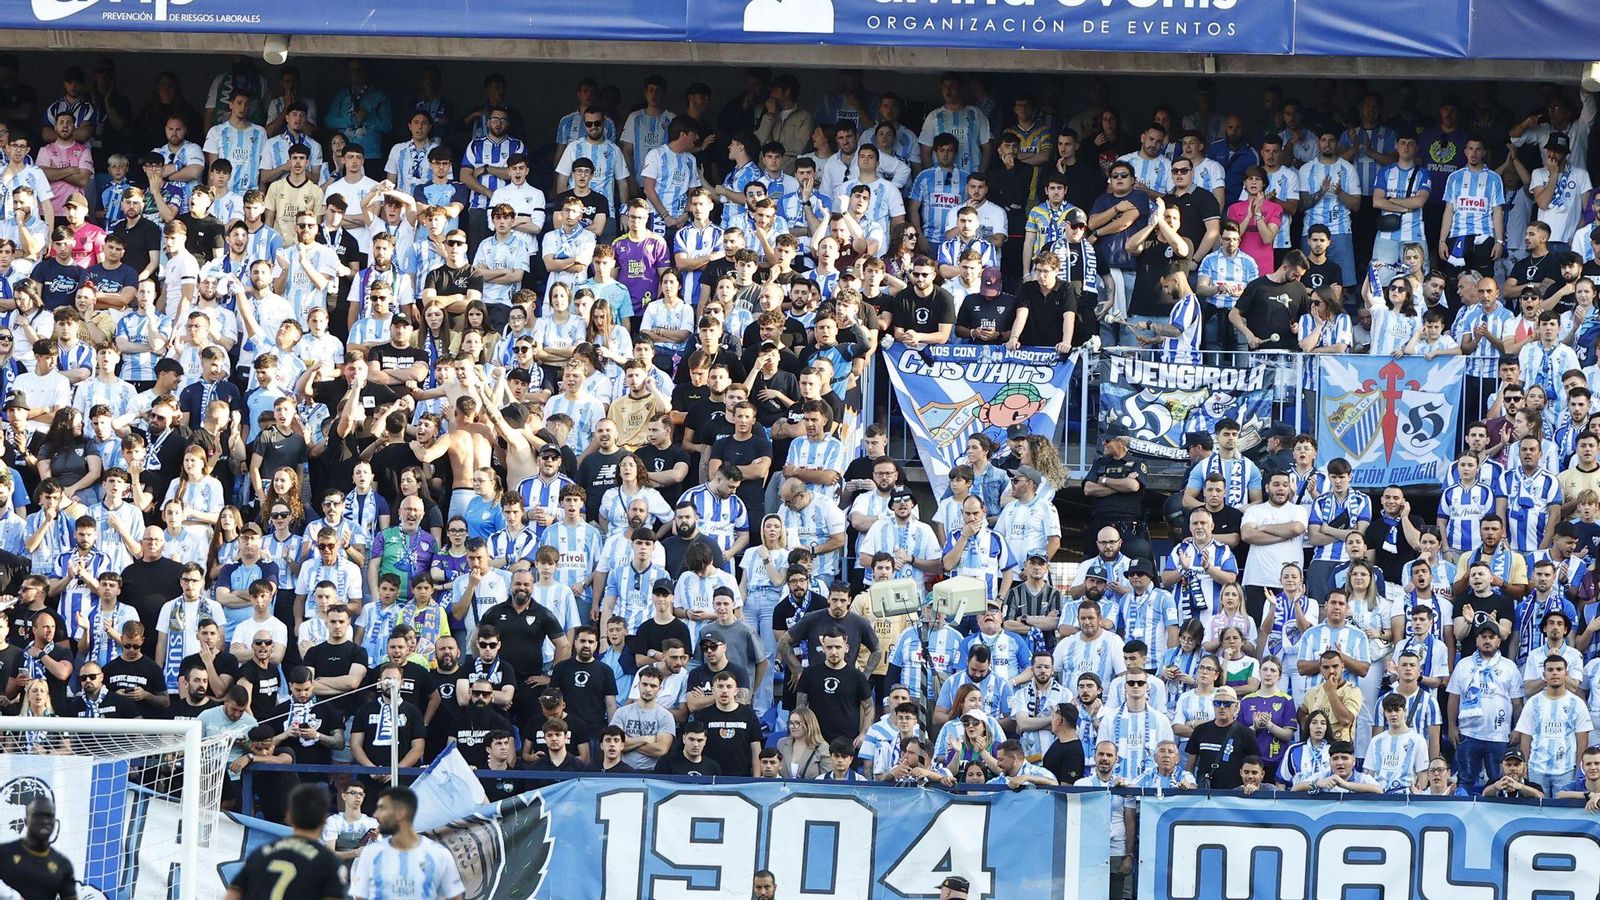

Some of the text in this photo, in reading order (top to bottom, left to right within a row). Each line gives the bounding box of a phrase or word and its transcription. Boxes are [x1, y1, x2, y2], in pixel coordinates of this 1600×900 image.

[103, 12, 152, 21] PREVENCIÓN
[181, 14, 214, 22] RIESGOS
[216, 14, 261, 23] LABORALES
[867, 15, 1237, 36] ORGANIZACIÓN DE EVENTOS
[1460, 198, 1485, 207] Tivoli
[953, 346, 976, 358] CON
[1110, 354, 1266, 392] FUENGIROLA
[560, 554, 585, 563] Tivoli
[166, 634, 182, 677] SUR
[597, 788, 995, 900] 1904
[268, 860, 297, 900] 7
